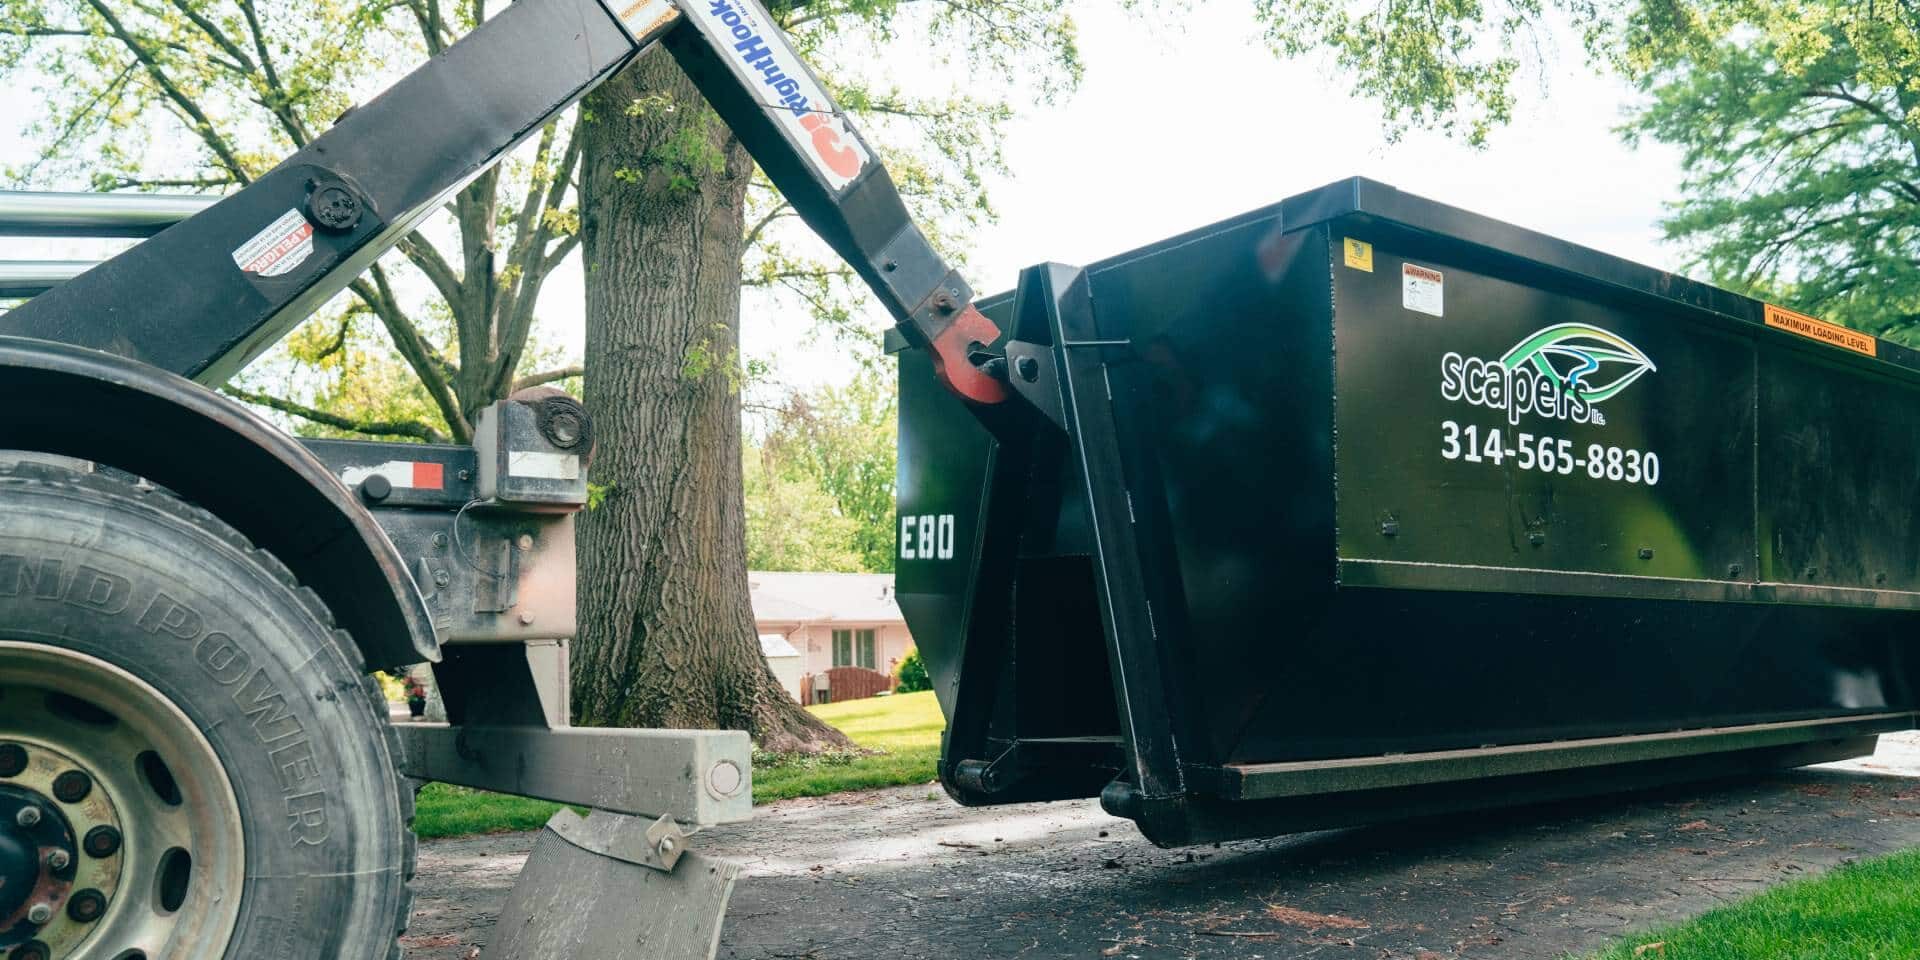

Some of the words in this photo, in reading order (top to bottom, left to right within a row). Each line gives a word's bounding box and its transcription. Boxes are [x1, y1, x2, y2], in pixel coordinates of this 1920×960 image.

[708, 0, 811, 117] RightHook
[1410, 266, 1441, 282] WARNING
[1772, 312, 1812, 333] MAXIMUM
[1812, 326, 1846, 344] LOADING
[1846, 338, 1869, 352] LEVEL
[1441, 351, 1592, 425] scapers
[1441, 420, 1660, 486] 314-565-8830
[900, 513, 955, 561] E80
[136, 592, 330, 847] POWER
